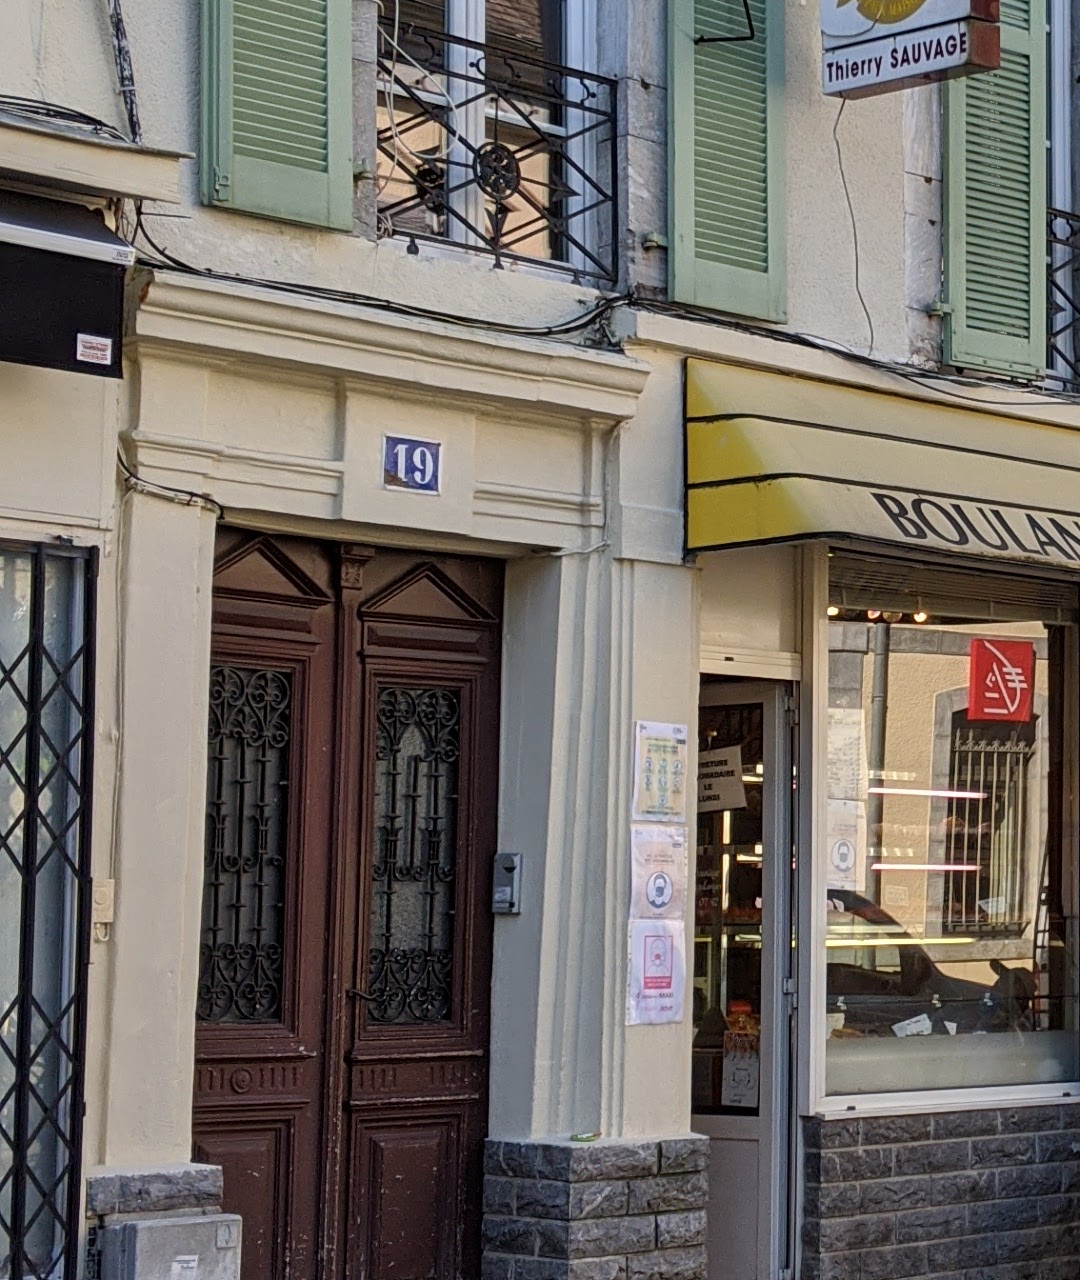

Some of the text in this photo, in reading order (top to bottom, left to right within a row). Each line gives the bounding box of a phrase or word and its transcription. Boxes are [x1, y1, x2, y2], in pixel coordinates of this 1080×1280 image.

[826, 32, 967, 83] Thierry SAUVAGE
[393, 444, 434, 484] 19
[698, 793, 720, 802] LUNDI
